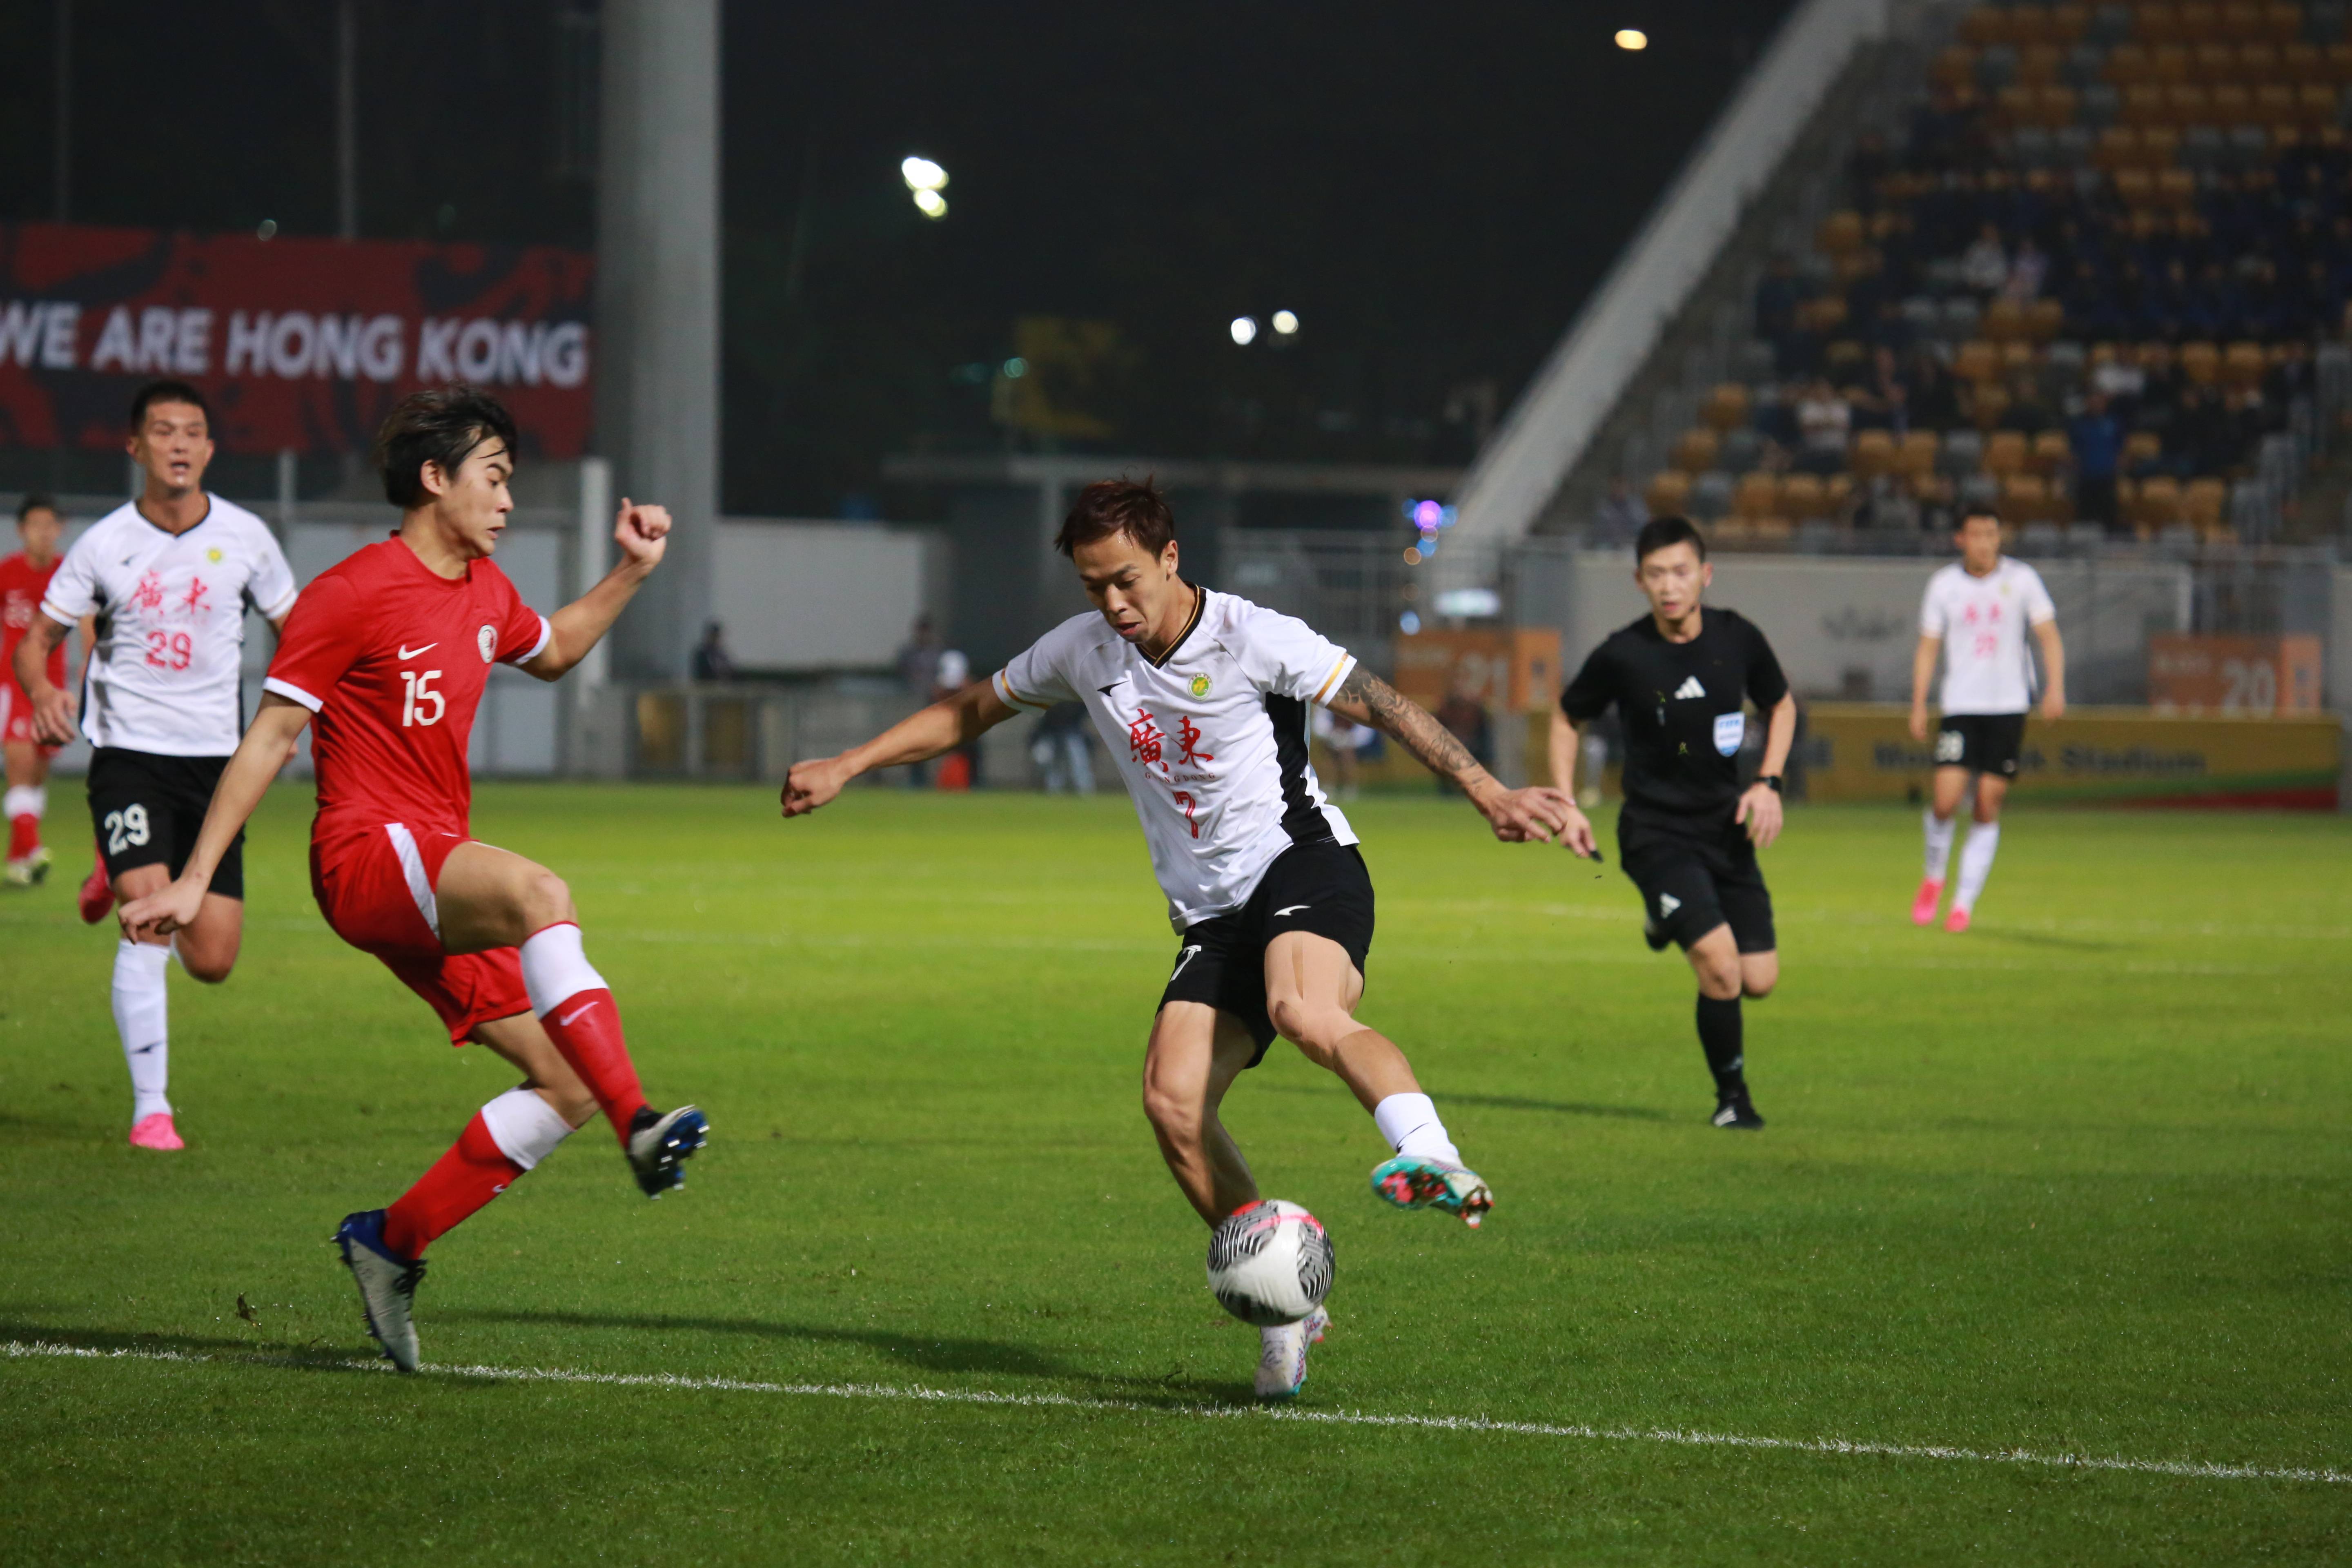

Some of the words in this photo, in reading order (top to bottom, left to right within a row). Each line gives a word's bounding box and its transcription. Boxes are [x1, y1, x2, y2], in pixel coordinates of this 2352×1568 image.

[0, 300, 81, 369] WE
[92, 304, 213, 375] ARE
[225, 310, 404, 383] HONG
[416, 316, 588, 388] KONG
[145, 631, 192, 670] 29
[400, 670, 445, 727] 15
[2221, 657, 2276, 719] 20
[1127, 708, 1214, 773] 廣東
[105, 803, 151, 855] 29
[1173, 791, 1199, 839] 7
[1169, 944, 1202, 982] 7
